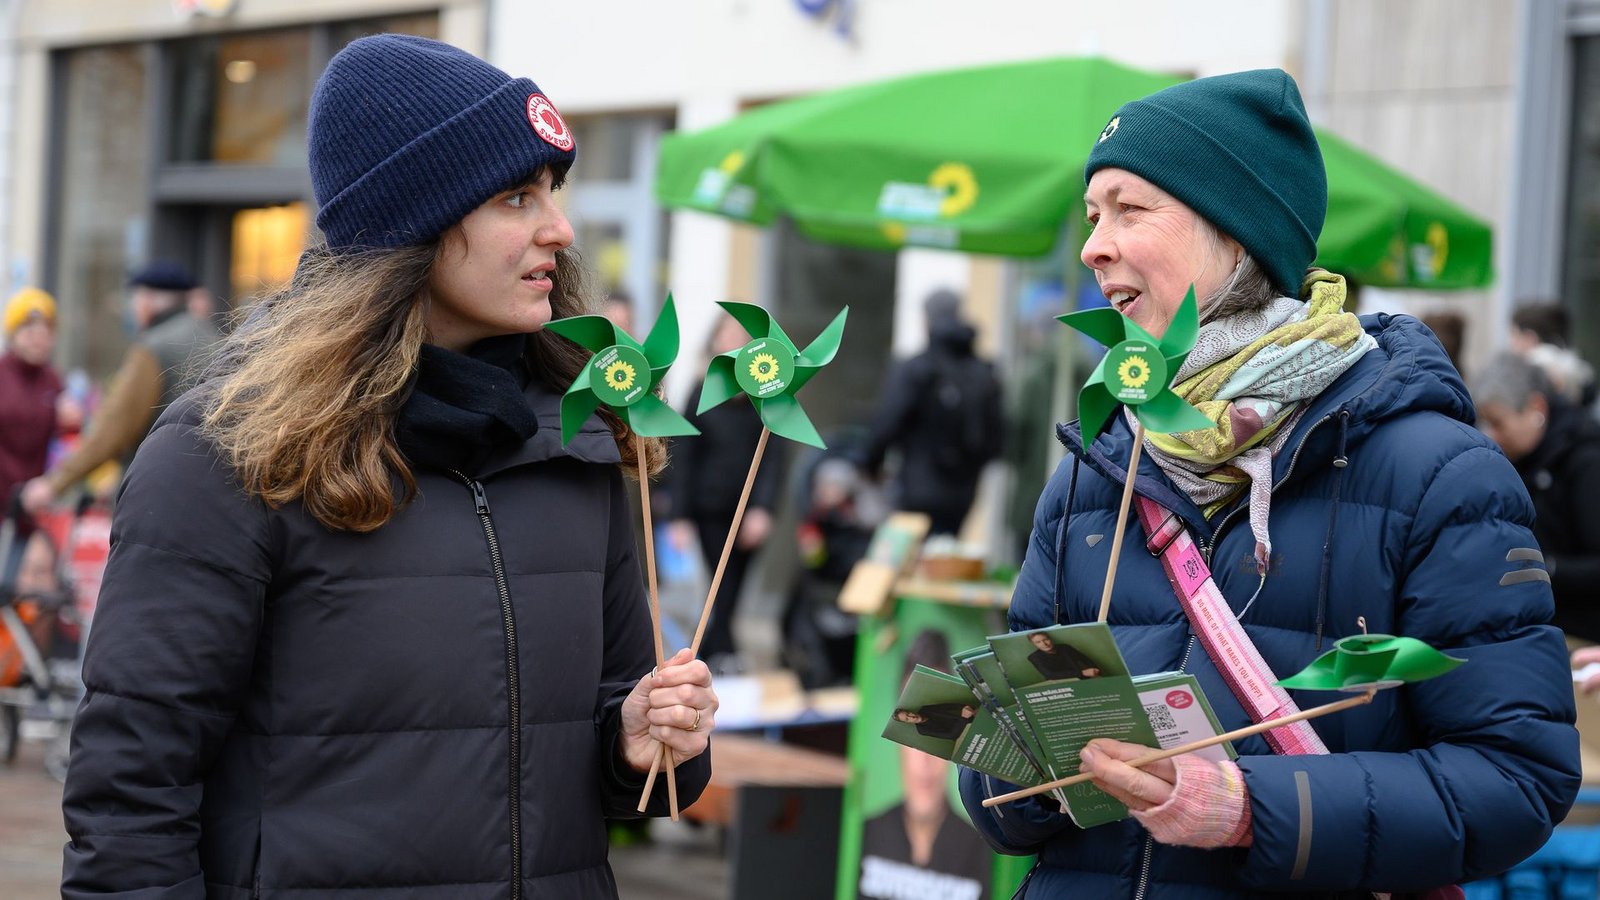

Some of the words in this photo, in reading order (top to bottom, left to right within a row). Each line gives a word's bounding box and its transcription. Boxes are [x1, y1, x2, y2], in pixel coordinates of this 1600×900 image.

[540, 128, 570, 147] SWEDEN
[1202, 607, 1214, 623] MORE
[1211, 622, 1219, 631] OF
[1216, 632, 1229, 647] WHAT
[1226, 646, 1241, 667] MAKES
[1239, 666, 1249, 679] YOU
